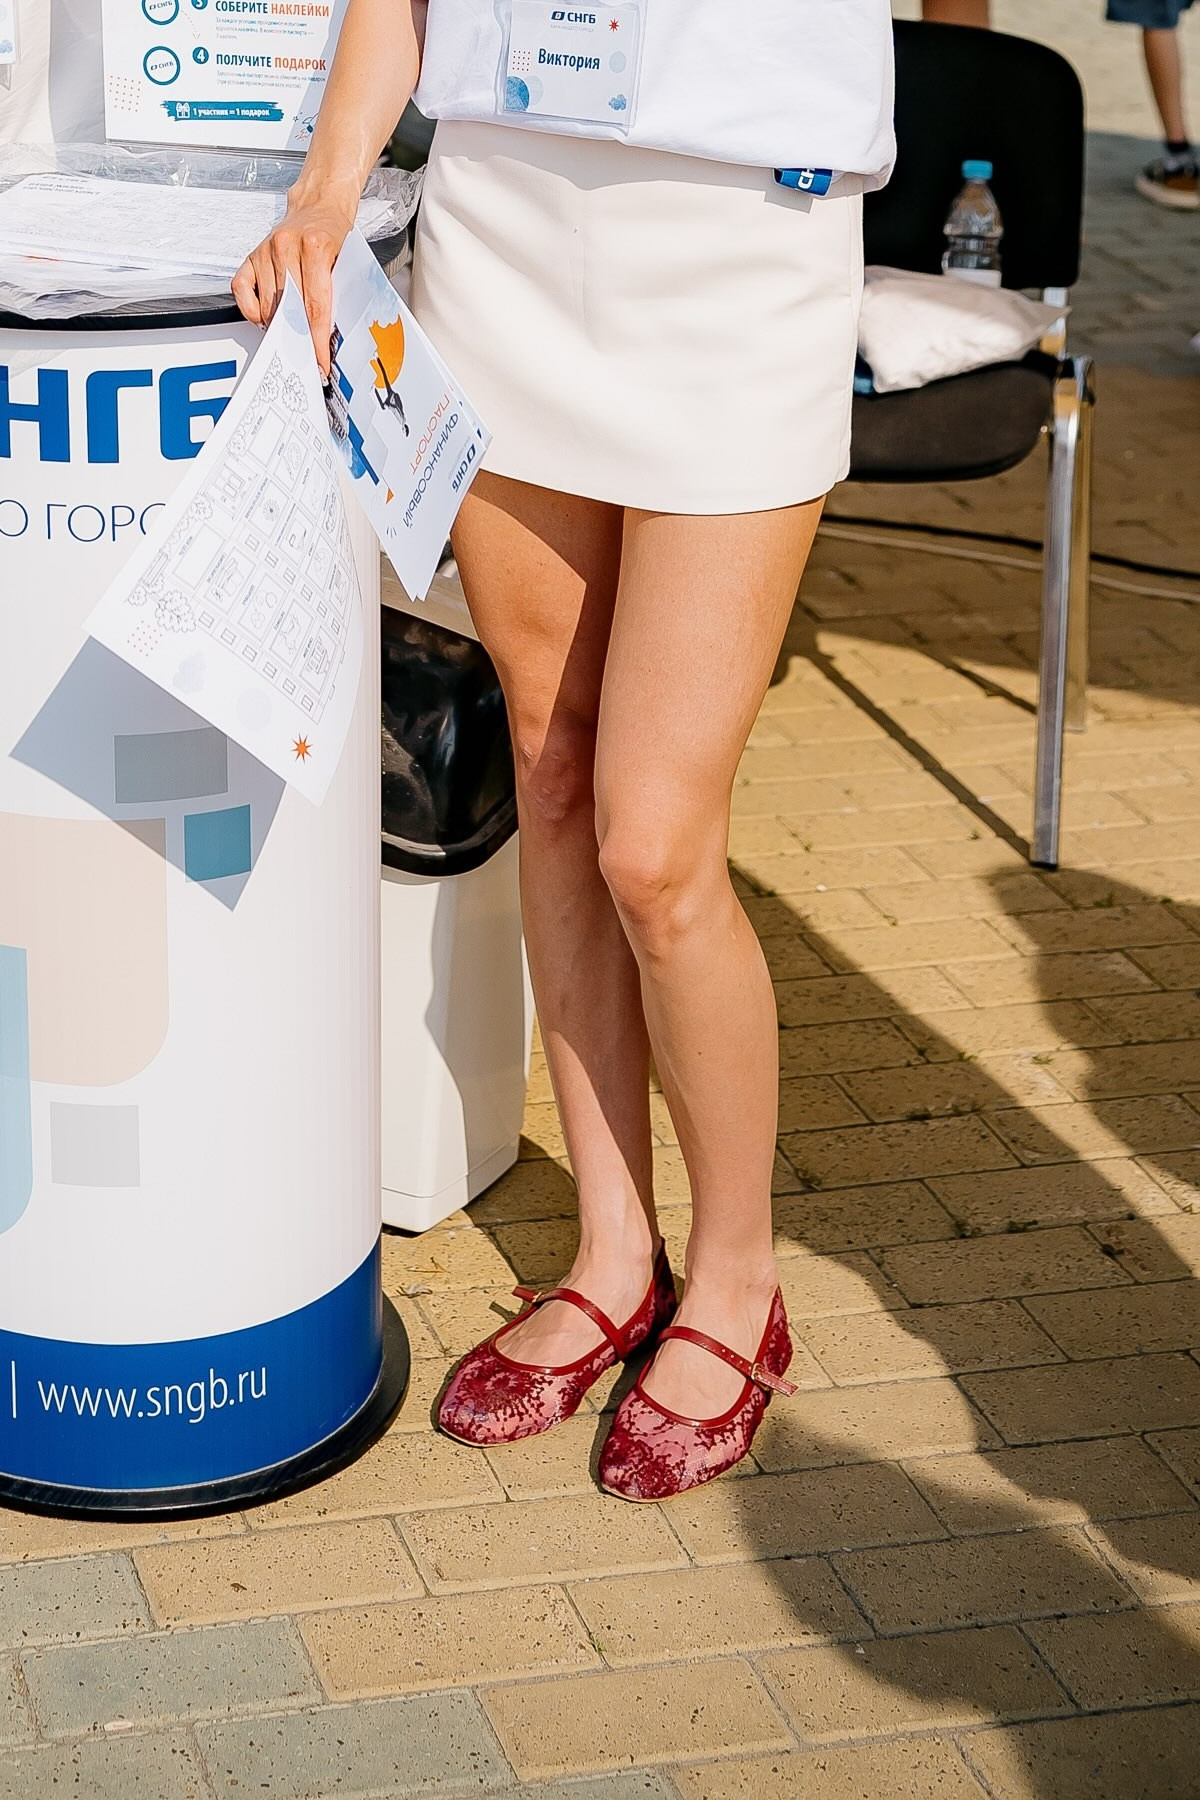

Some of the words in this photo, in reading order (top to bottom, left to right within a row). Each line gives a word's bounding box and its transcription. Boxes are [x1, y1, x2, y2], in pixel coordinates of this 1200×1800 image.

[215, 1, 268, 14] СОБЕРИТЕ
[271, 3, 329, 17] НАКЛЕЙКИ
[567, 12, 596, 24] СНГБ
[197, 49, 205, 62] 4
[216, 54, 272, 68] ПОЛУЧИТЕ
[274, 57, 327, 71] ПОДАРОК
[538, 48, 600, 72] Виктория
[198, 108, 228, 117] участник
[241, 108, 270, 117] подарок
[410, 394, 450, 476] ПАСПОРТ
[402, 413, 459, 529] ФИНАНСОВЫЙ
[452, 460, 469, 493] СНГБ
[38, 1366, 268, 1424] www.sngb.ru
